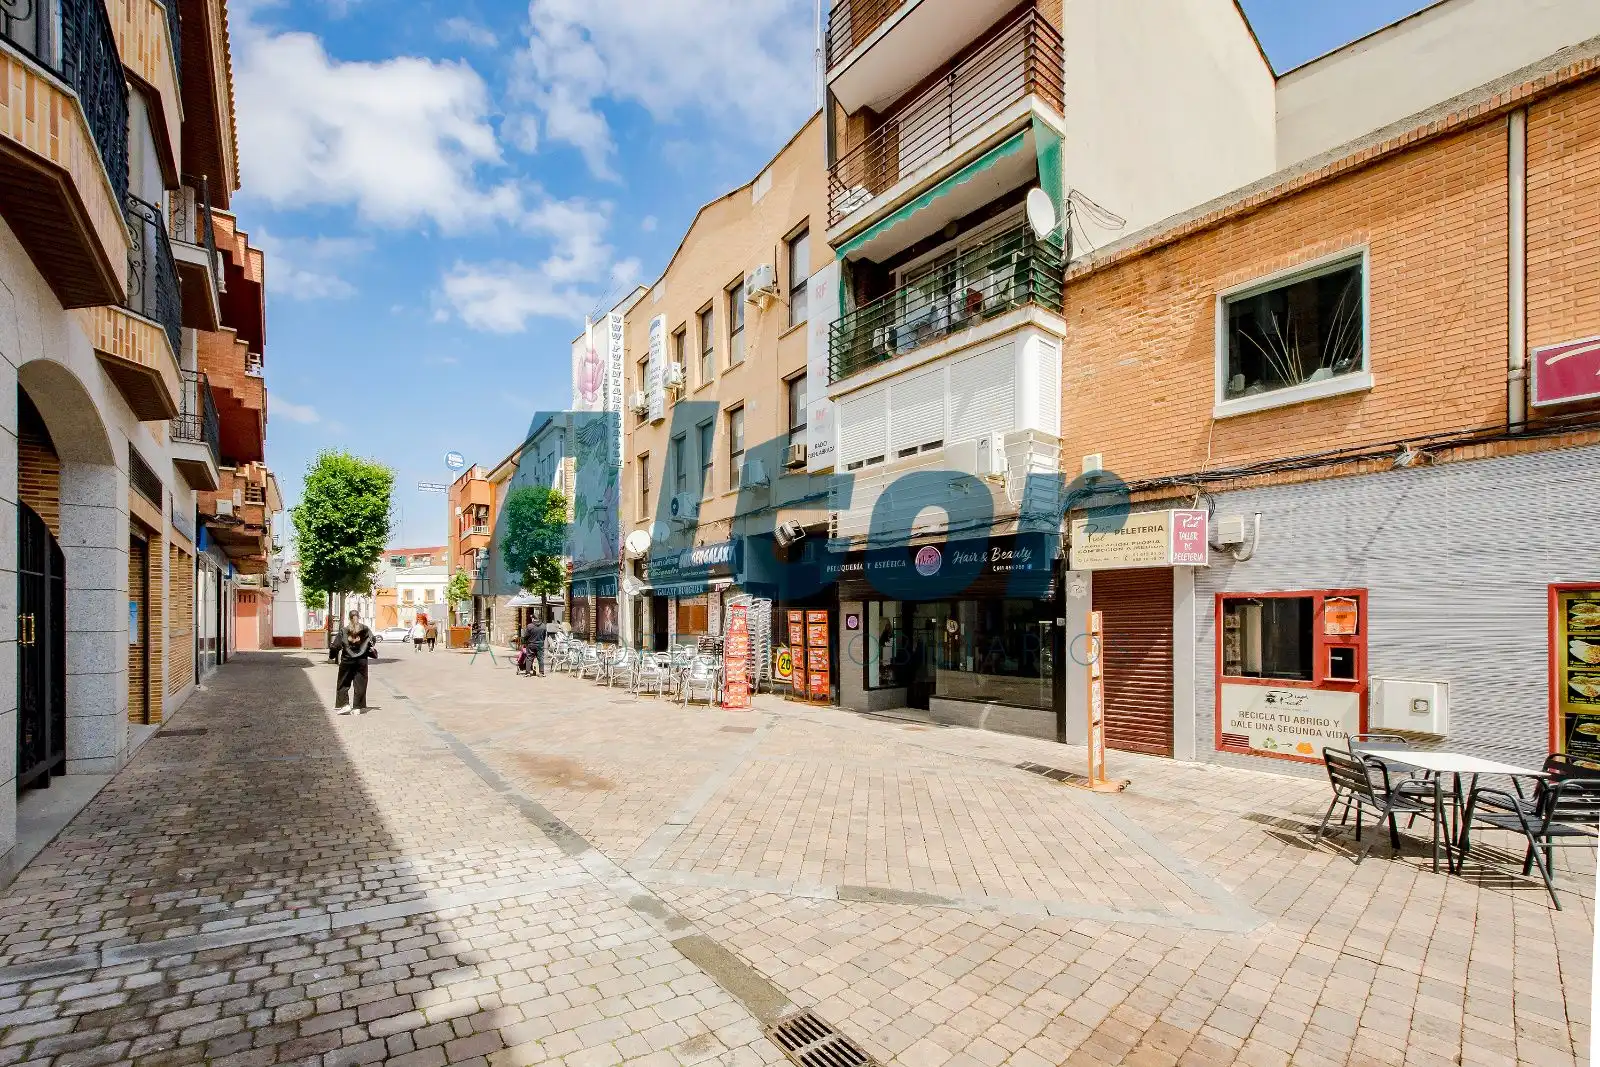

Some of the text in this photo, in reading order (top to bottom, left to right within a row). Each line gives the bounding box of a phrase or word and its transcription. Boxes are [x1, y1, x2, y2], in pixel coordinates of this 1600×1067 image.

[1113, 524, 1165, 535] PELETERIA
[1178, 531, 1198, 541] TALLER
[1184, 543, 1193, 551] DE
[951, 550, 979, 565] Hair
[979, 551, 988, 562] &
[989, 546, 1033, 563] Beauty
[780, 658, 791, 670] 20
[1238, 711, 1340, 728] RECICLA TU ABRIGO Y
[1230, 719, 1350, 740] DALE UNA SEGUNDA VIDA
